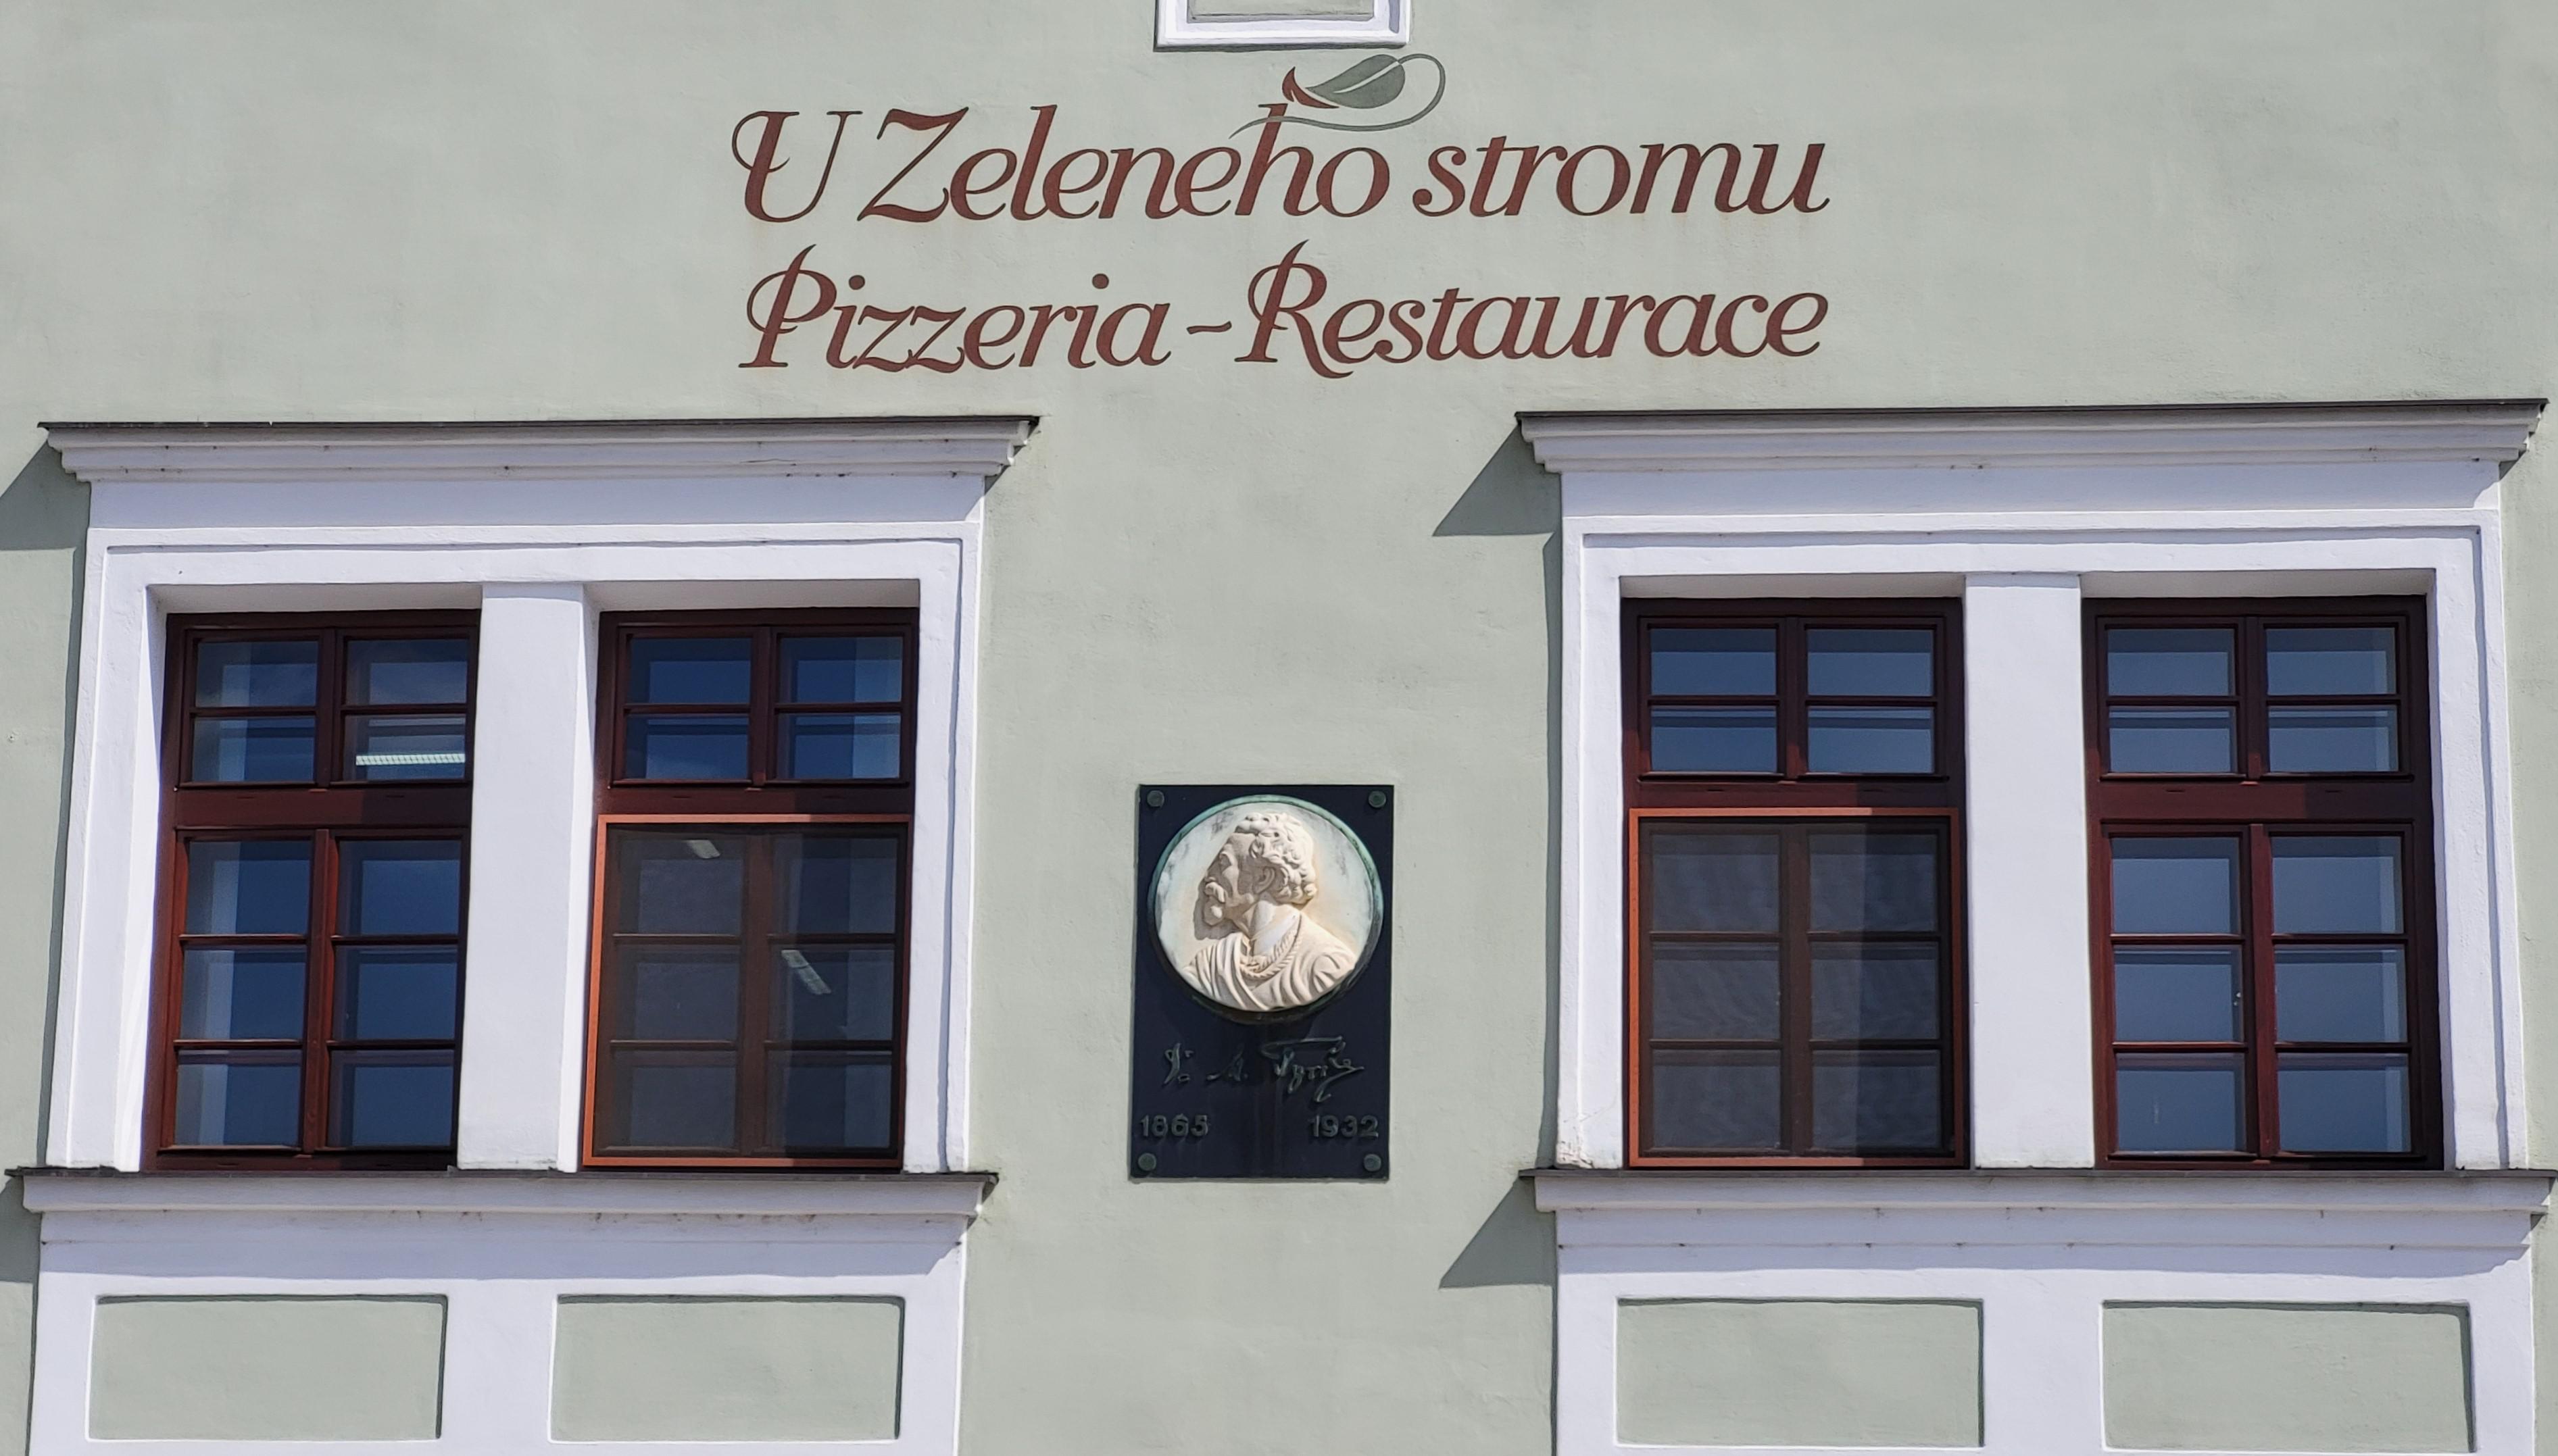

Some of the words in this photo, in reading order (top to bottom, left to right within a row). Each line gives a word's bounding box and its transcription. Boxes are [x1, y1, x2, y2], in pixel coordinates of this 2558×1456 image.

[731, 109, 863, 224] U
[1411, 134, 1830, 218] stromu
[1140, 1113, 1210, 1137] 1865
[1310, 1115, 1379, 1138] 1932
